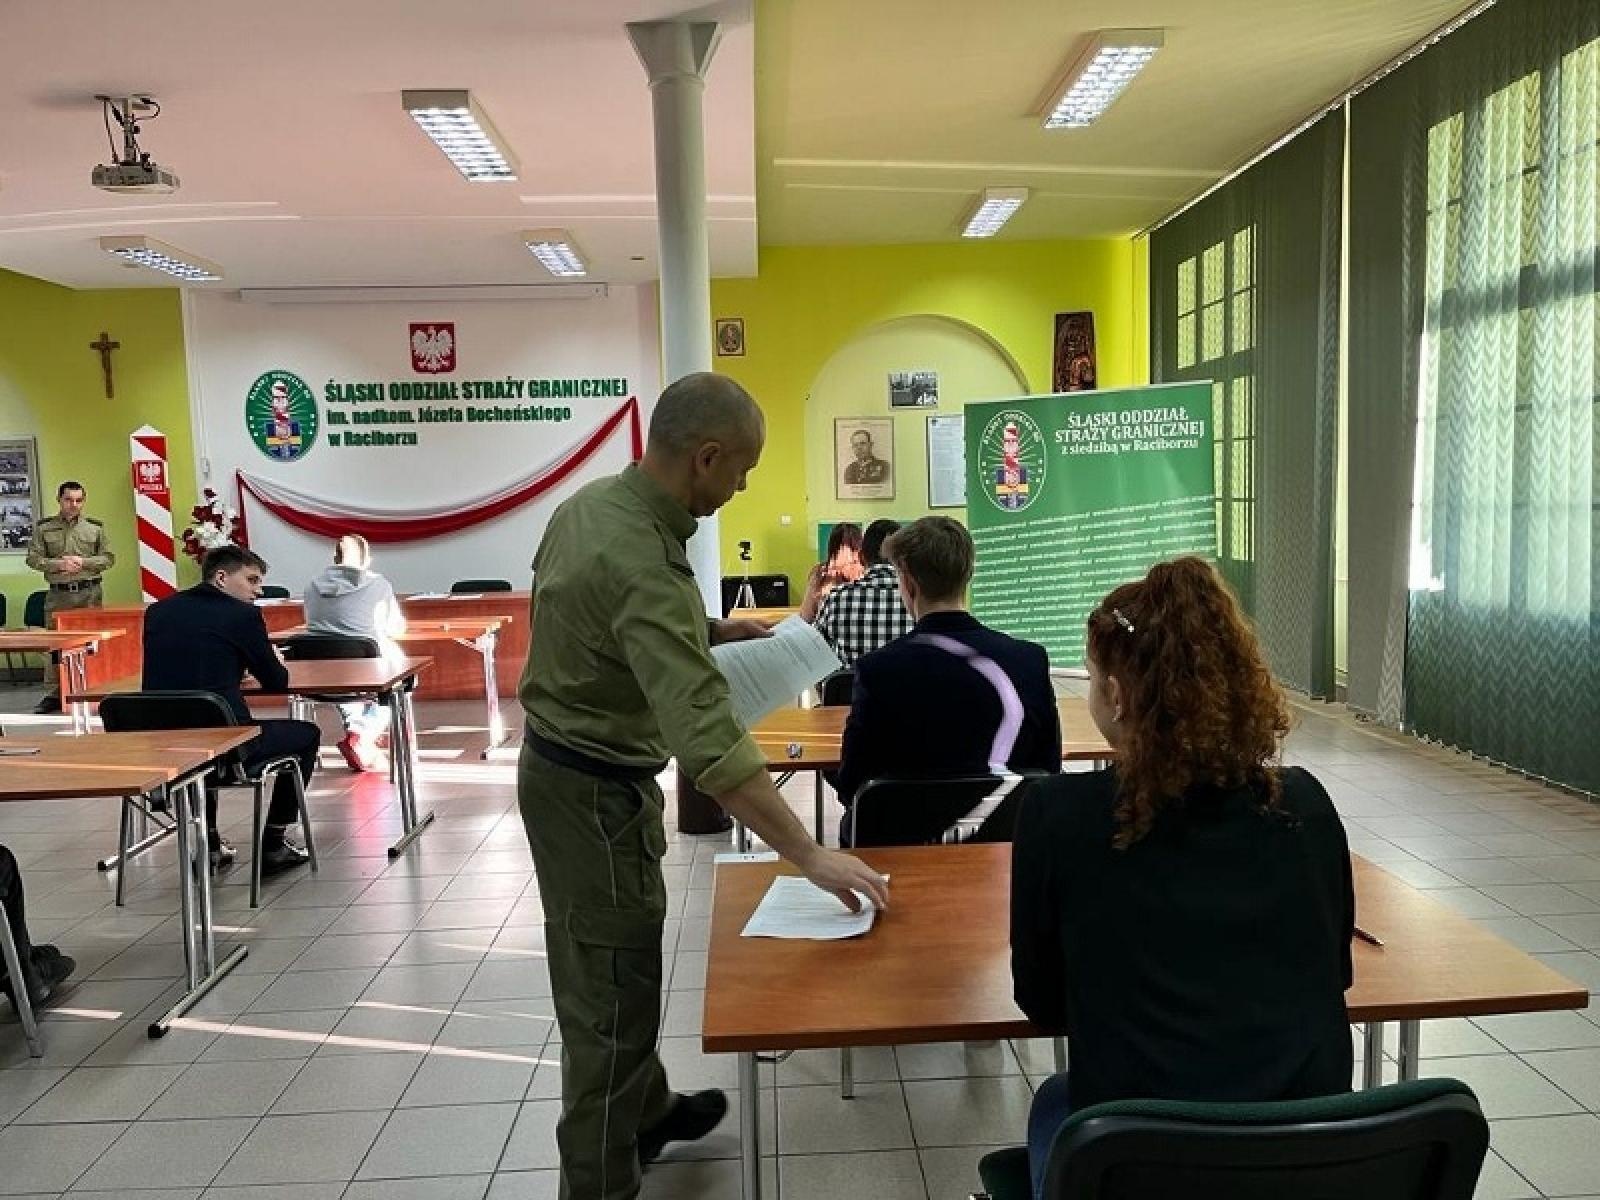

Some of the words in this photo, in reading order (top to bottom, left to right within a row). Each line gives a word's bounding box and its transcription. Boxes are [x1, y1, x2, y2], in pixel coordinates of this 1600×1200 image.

[325, 378, 385, 405] ŚLĄSKI
[388, 382, 459, 401] ODDZIAŁ
[461, 376, 524, 400] STRAŻY
[527, 379, 628, 399] GRANICZNEJ
[327, 409, 350, 425] im.
[418, 405, 463, 423] Józefa
[466, 404, 572, 423] Bocheńskiego
[1067, 411, 1117, 429] ŚLĄSKI
[1120, 407, 1189, 424] ODDZIAŁ
[328, 433, 341, 446] w
[344, 430, 418, 446] Raciborzu
[1055, 425, 1109, 443] STRAŻY
[1111, 420, 1205, 439] GRANICZNEJ
[1061, 445, 1069, 455] z
[1070, 441, 1119, 455] siedzibą
[1120, 443, 1132, 451] w
[1133, 439, 1199, 450] Raciborzu
